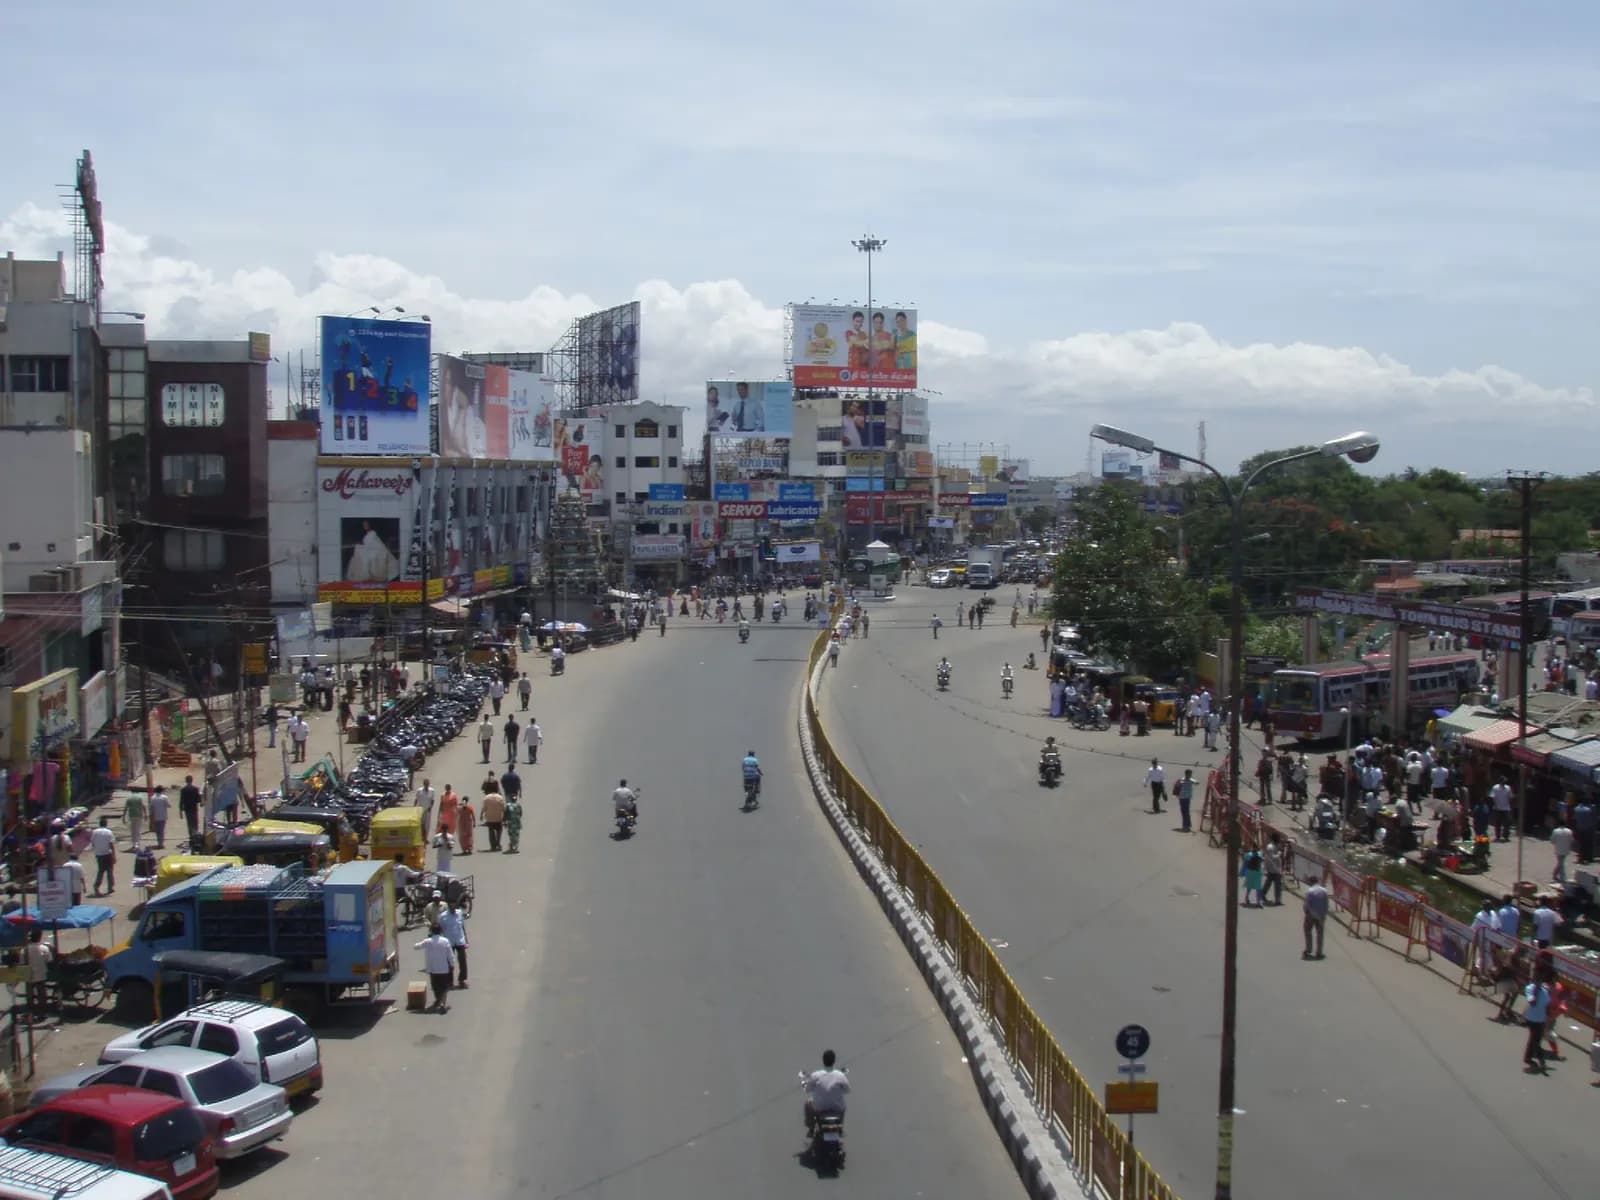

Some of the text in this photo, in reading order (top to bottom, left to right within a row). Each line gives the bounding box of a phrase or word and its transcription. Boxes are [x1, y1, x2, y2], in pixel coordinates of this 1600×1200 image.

[346, 372, 356, 391] 1
[367, 380, 380, 399] 2
[387, 388, 398, 406] 3
[406, 394, 417, 410] 4
[647, 504, 682, 516] Indian
[720, 504, 818, 517] SERVO Lubricants
[1399, 609, 1437, 625] TOWN
[1439, 615, 1470, 630] BUS
[1471, 621, 1521, 639] STAND
